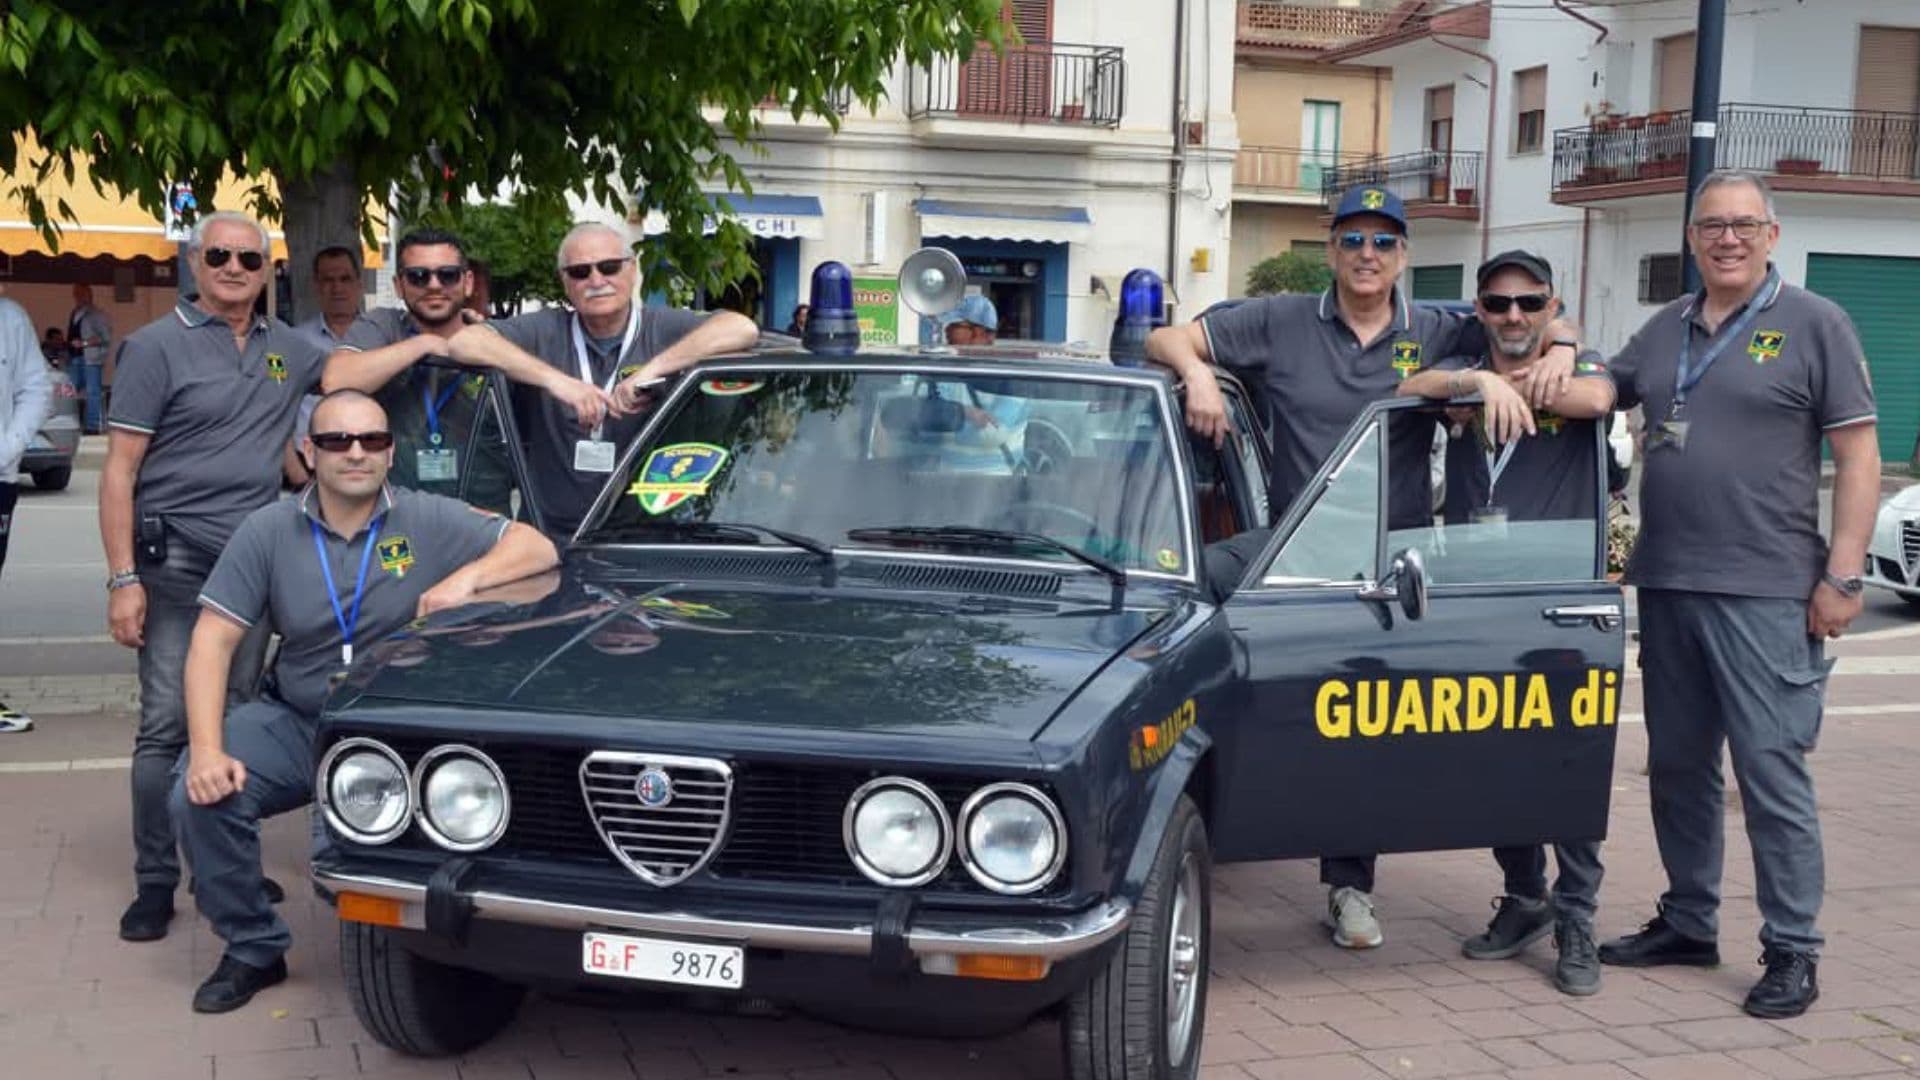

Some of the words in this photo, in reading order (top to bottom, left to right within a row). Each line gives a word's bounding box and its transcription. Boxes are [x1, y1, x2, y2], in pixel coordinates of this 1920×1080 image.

[1314, 673, 1555, 739] GUARDIA
[1571, 669, 1617, 727] di
[672, 951, 734, 980] 9876
